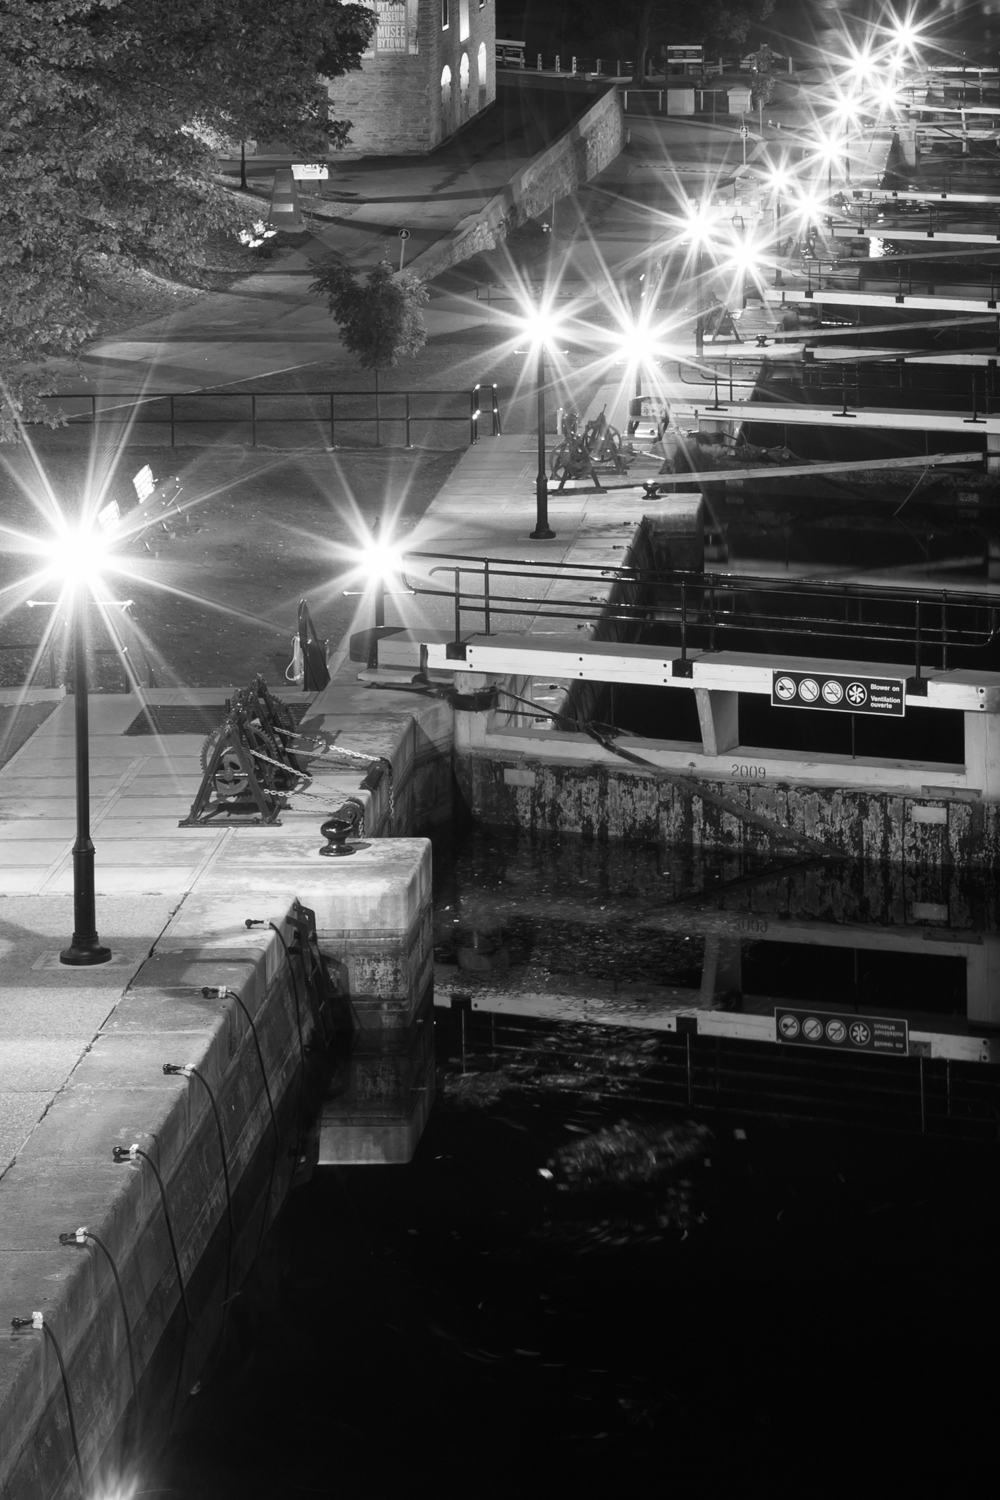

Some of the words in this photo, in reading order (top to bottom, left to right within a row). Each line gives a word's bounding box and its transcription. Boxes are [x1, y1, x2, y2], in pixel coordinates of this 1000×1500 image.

[377, 38, 405, 48] BYTOWN
[870, 683, 890, 691] Blower
[870, 695, 901, 703] Ventilation
[731, 763, 766, 779] 2009
